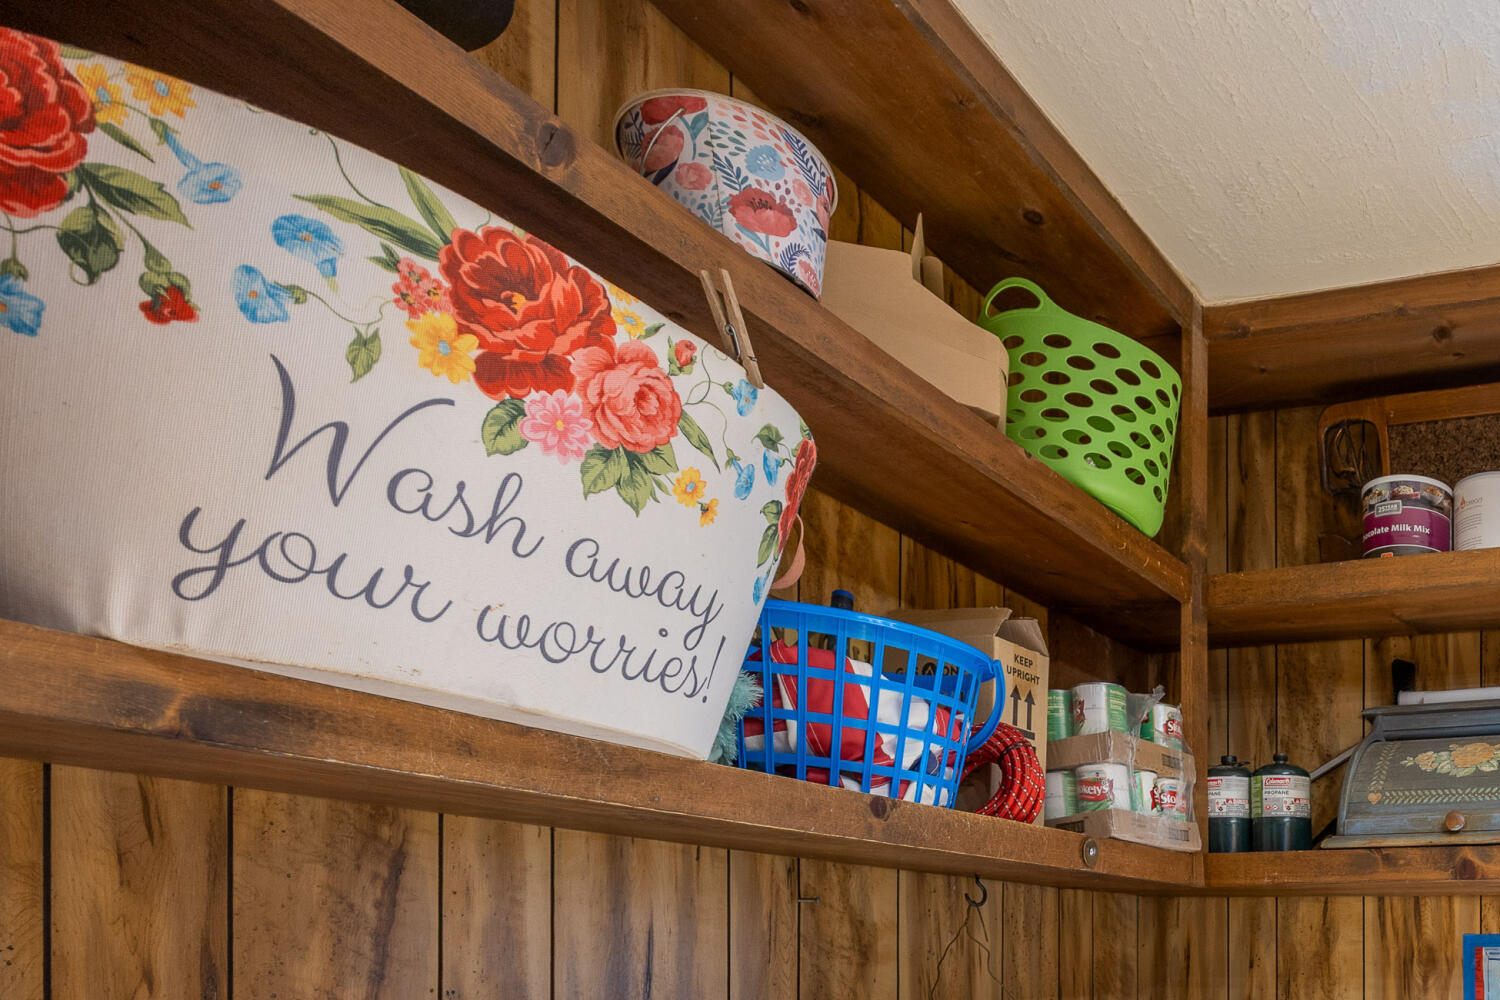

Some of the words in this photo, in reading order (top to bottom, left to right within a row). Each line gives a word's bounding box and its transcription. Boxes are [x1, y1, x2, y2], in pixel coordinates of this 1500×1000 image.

[264, 353, 544, 559] Wash
[565, 537, 725, 651] away
[1391, 523, 1412, 532] Milk
[1413, 524, 1431, 535] Mix
[171, 507, 453, 624] your
[476, 604, 727, 704] worries!
[1013, 653, 1034, 669] KEEP
[1006, 665, 1041, 686] UPRIGHT
